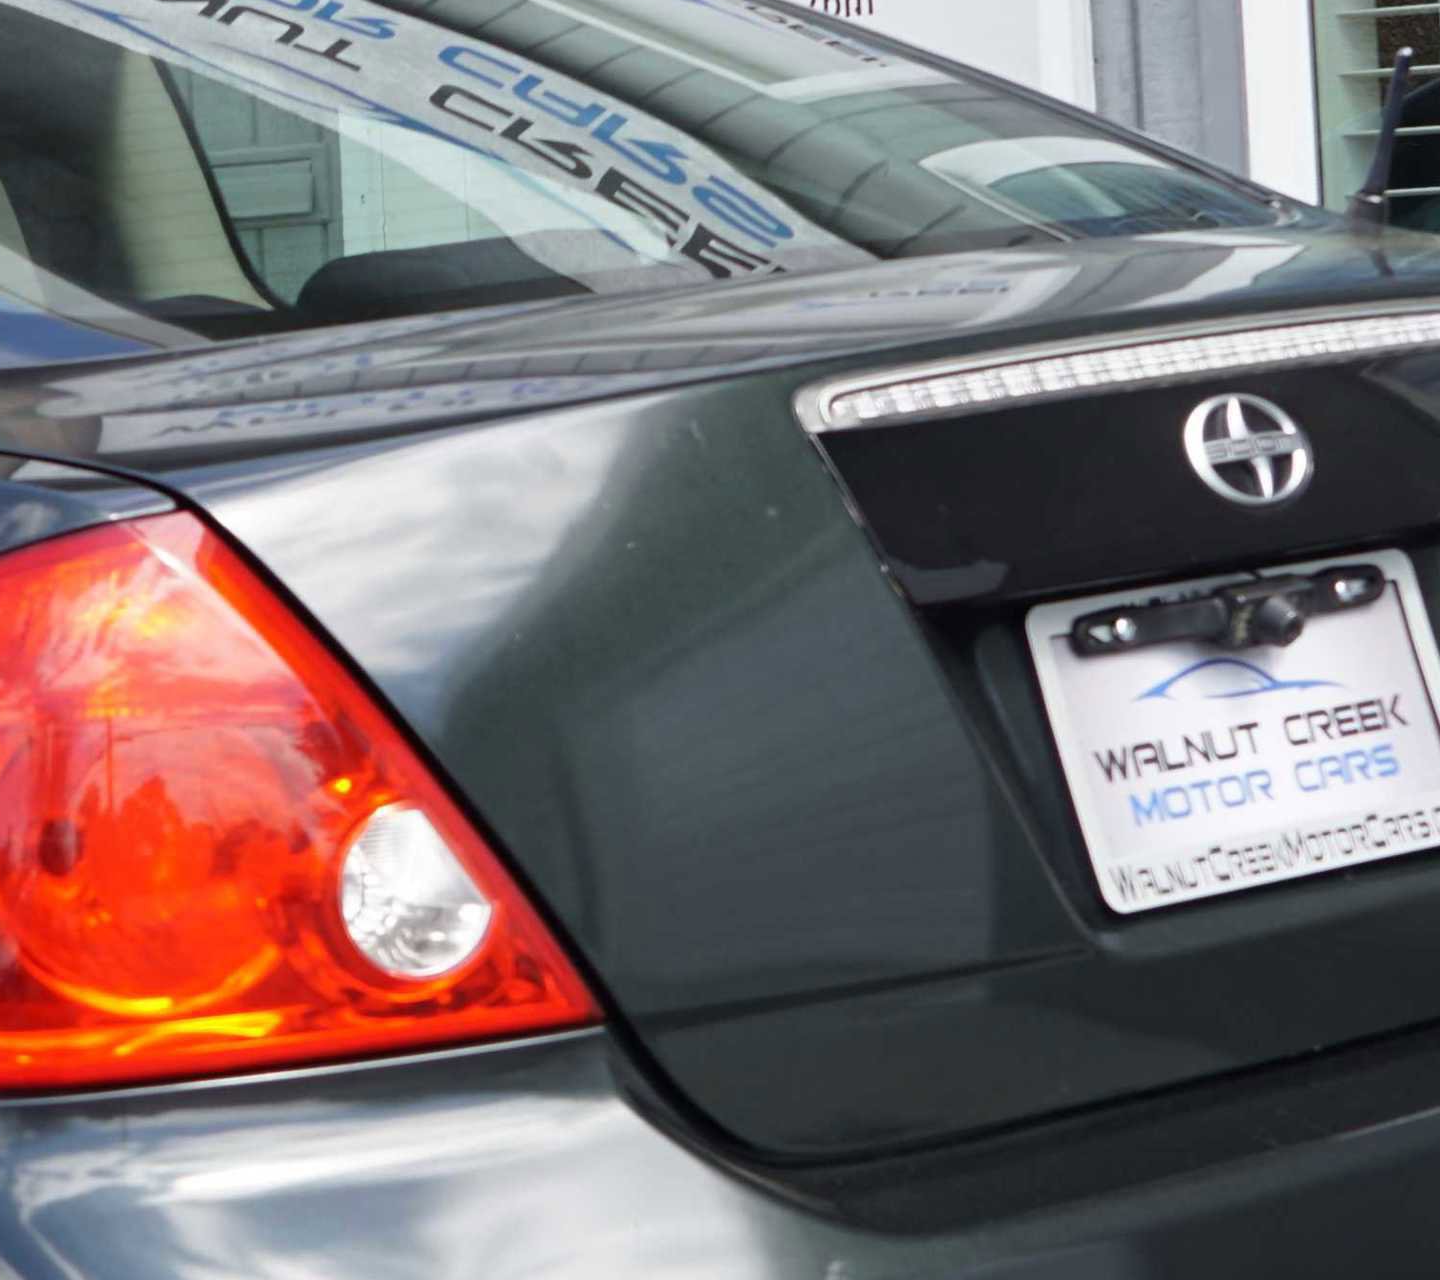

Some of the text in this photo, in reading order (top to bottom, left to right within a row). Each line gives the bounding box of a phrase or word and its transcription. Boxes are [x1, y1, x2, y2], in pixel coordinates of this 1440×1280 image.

[1092, 693, 1410, 784] WALNUT CREEK
[1128, 741, 1401, 825] MOTOR CARS
